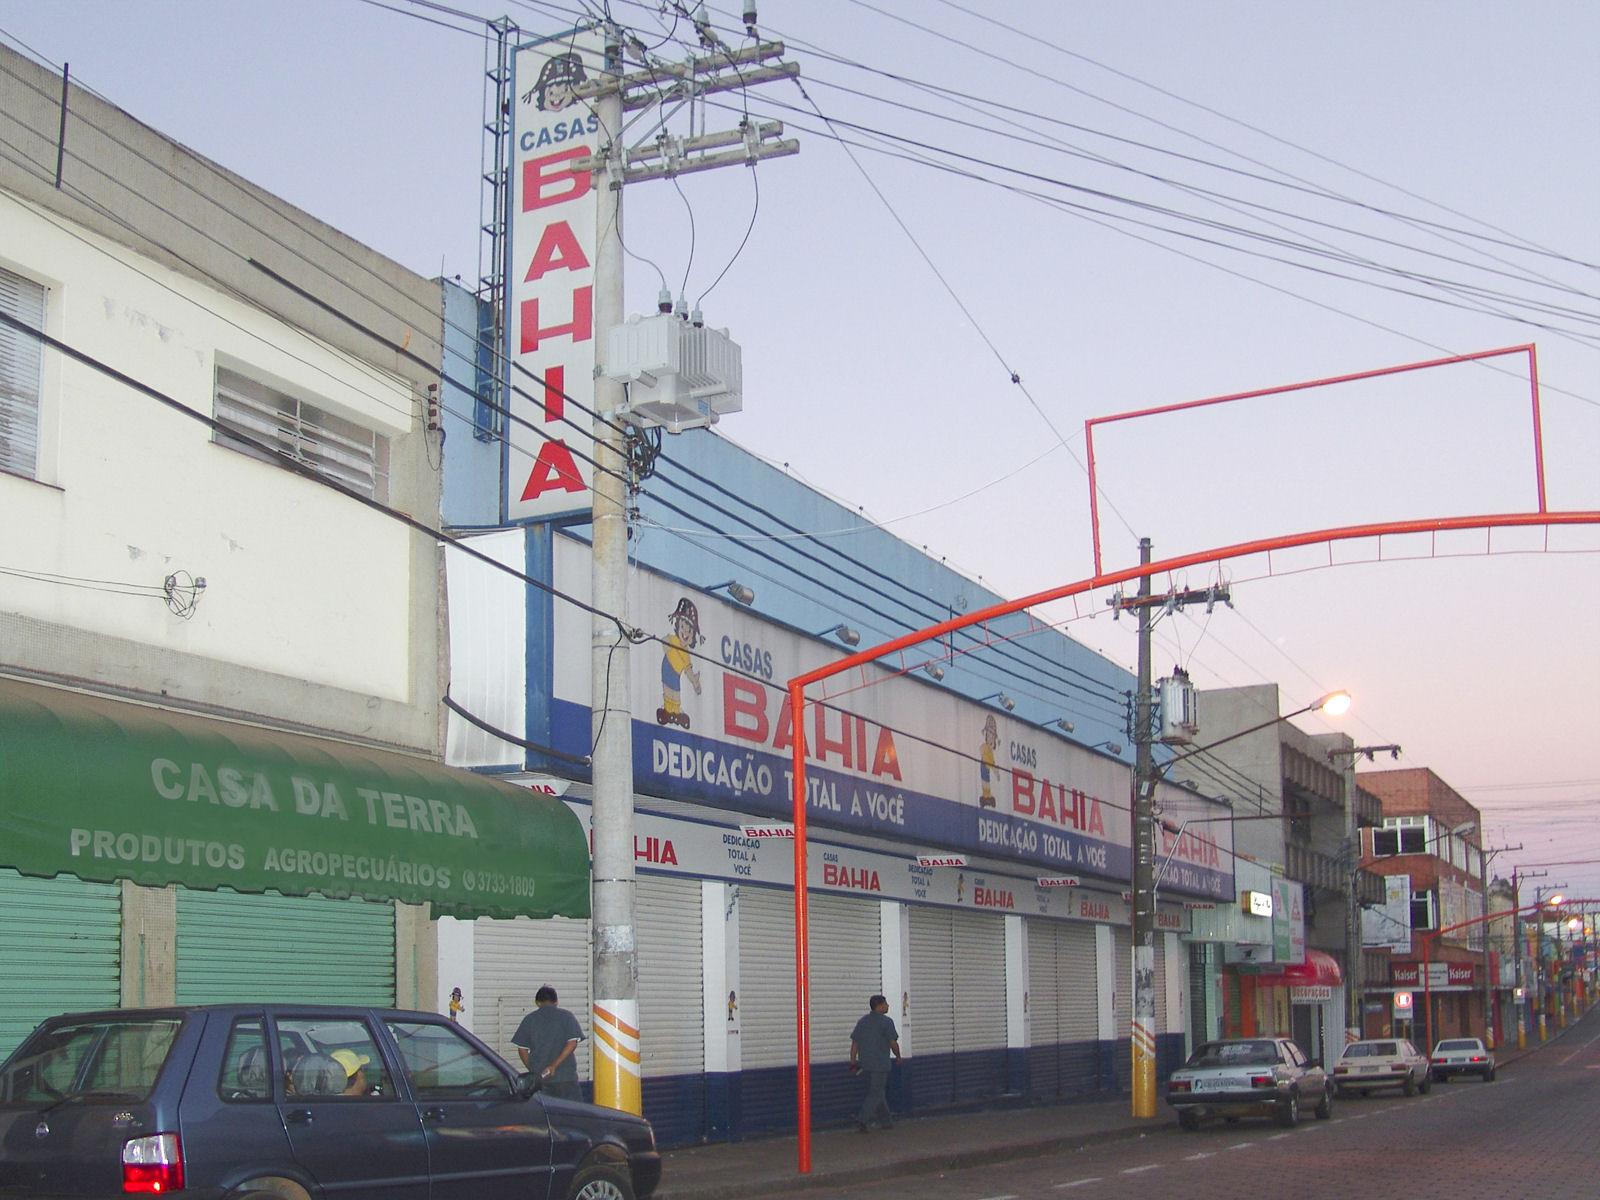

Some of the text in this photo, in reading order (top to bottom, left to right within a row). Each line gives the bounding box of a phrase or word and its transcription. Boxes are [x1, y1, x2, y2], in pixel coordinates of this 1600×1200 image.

[520, 114, 599, 151] CASAS
[521, 144, 594, 502] BAHIA
[721, 635, 773, 680] CASAS
[723, 671, 902, 782] BAHIA
[1010, 741, 1037, 769] CASAS
[652, 738, 773, 796] DEDICAÇÃO
[850, 790, 863, 817] A
[866, 790, 904, 825] VOCÊ
[151, 757, 479, 839] CASA DA TERRA
[1012, 767, 1105, 836] BAHIA
[745, 829, 795, 837] BAHIA
[978, 816, 1107, 869] DEDICAÇÃO TOTAL A VOCÊ
[1162, 820, 1219, 868] BAHIA
[70, 828, 246, 870] PRODUTOS
[263, 848, 452, 889] AGROPECUÁRIOS
[477, 871, 536, 897] 3733-1809
[728, 848, 757, 862] TOTAL A
[823, 851, 838, 863] CASAS
[920, 859, 964, 867] BAHIA
[824, 863, 881, 892] BAHIA
[1040, 879, 1078, 887] BAHIA
[1181, 867, 1200, 889] TOTAL
[974, 887, 1014, 909] BAHIA
[1080, 901, 1110, 920] BAHIA
[1158, 913, 1181, 928] BAHIA
[1394, 968, 1418, 981] Kaiser
[1449, 967, 1473, 980] Kaiser
